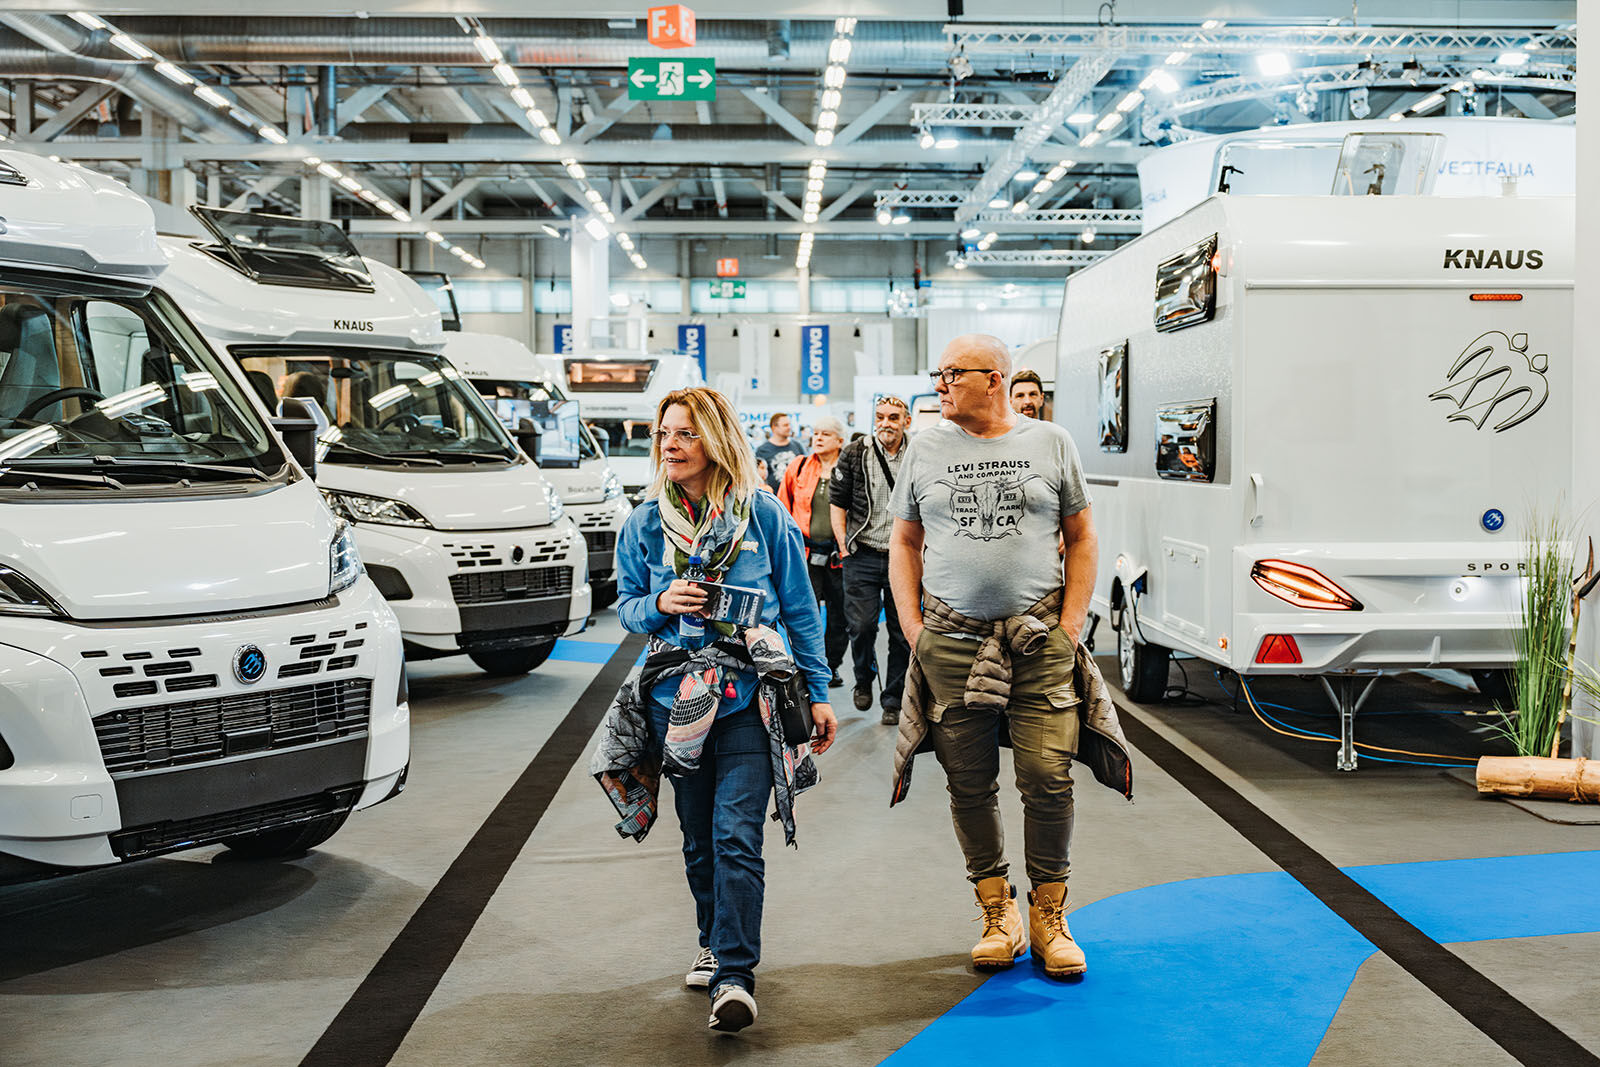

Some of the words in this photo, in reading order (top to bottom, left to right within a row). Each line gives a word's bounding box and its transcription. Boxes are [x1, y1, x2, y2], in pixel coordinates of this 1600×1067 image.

[652, 10, 666, 38] F
[1443, 249, 1544, 270] KNAUS
[333, 319, 374, 332] KNAUS
[947, 463, 974, 473] LEVI
[978, 460, 1030, 471] STRAUSS
[976, 470, 1017, 479] COMPANY
[960, 516, 977, 527] SF
[996, 515, 1016, 527] CA
[1467, 563, 1540, 572] SPOR
